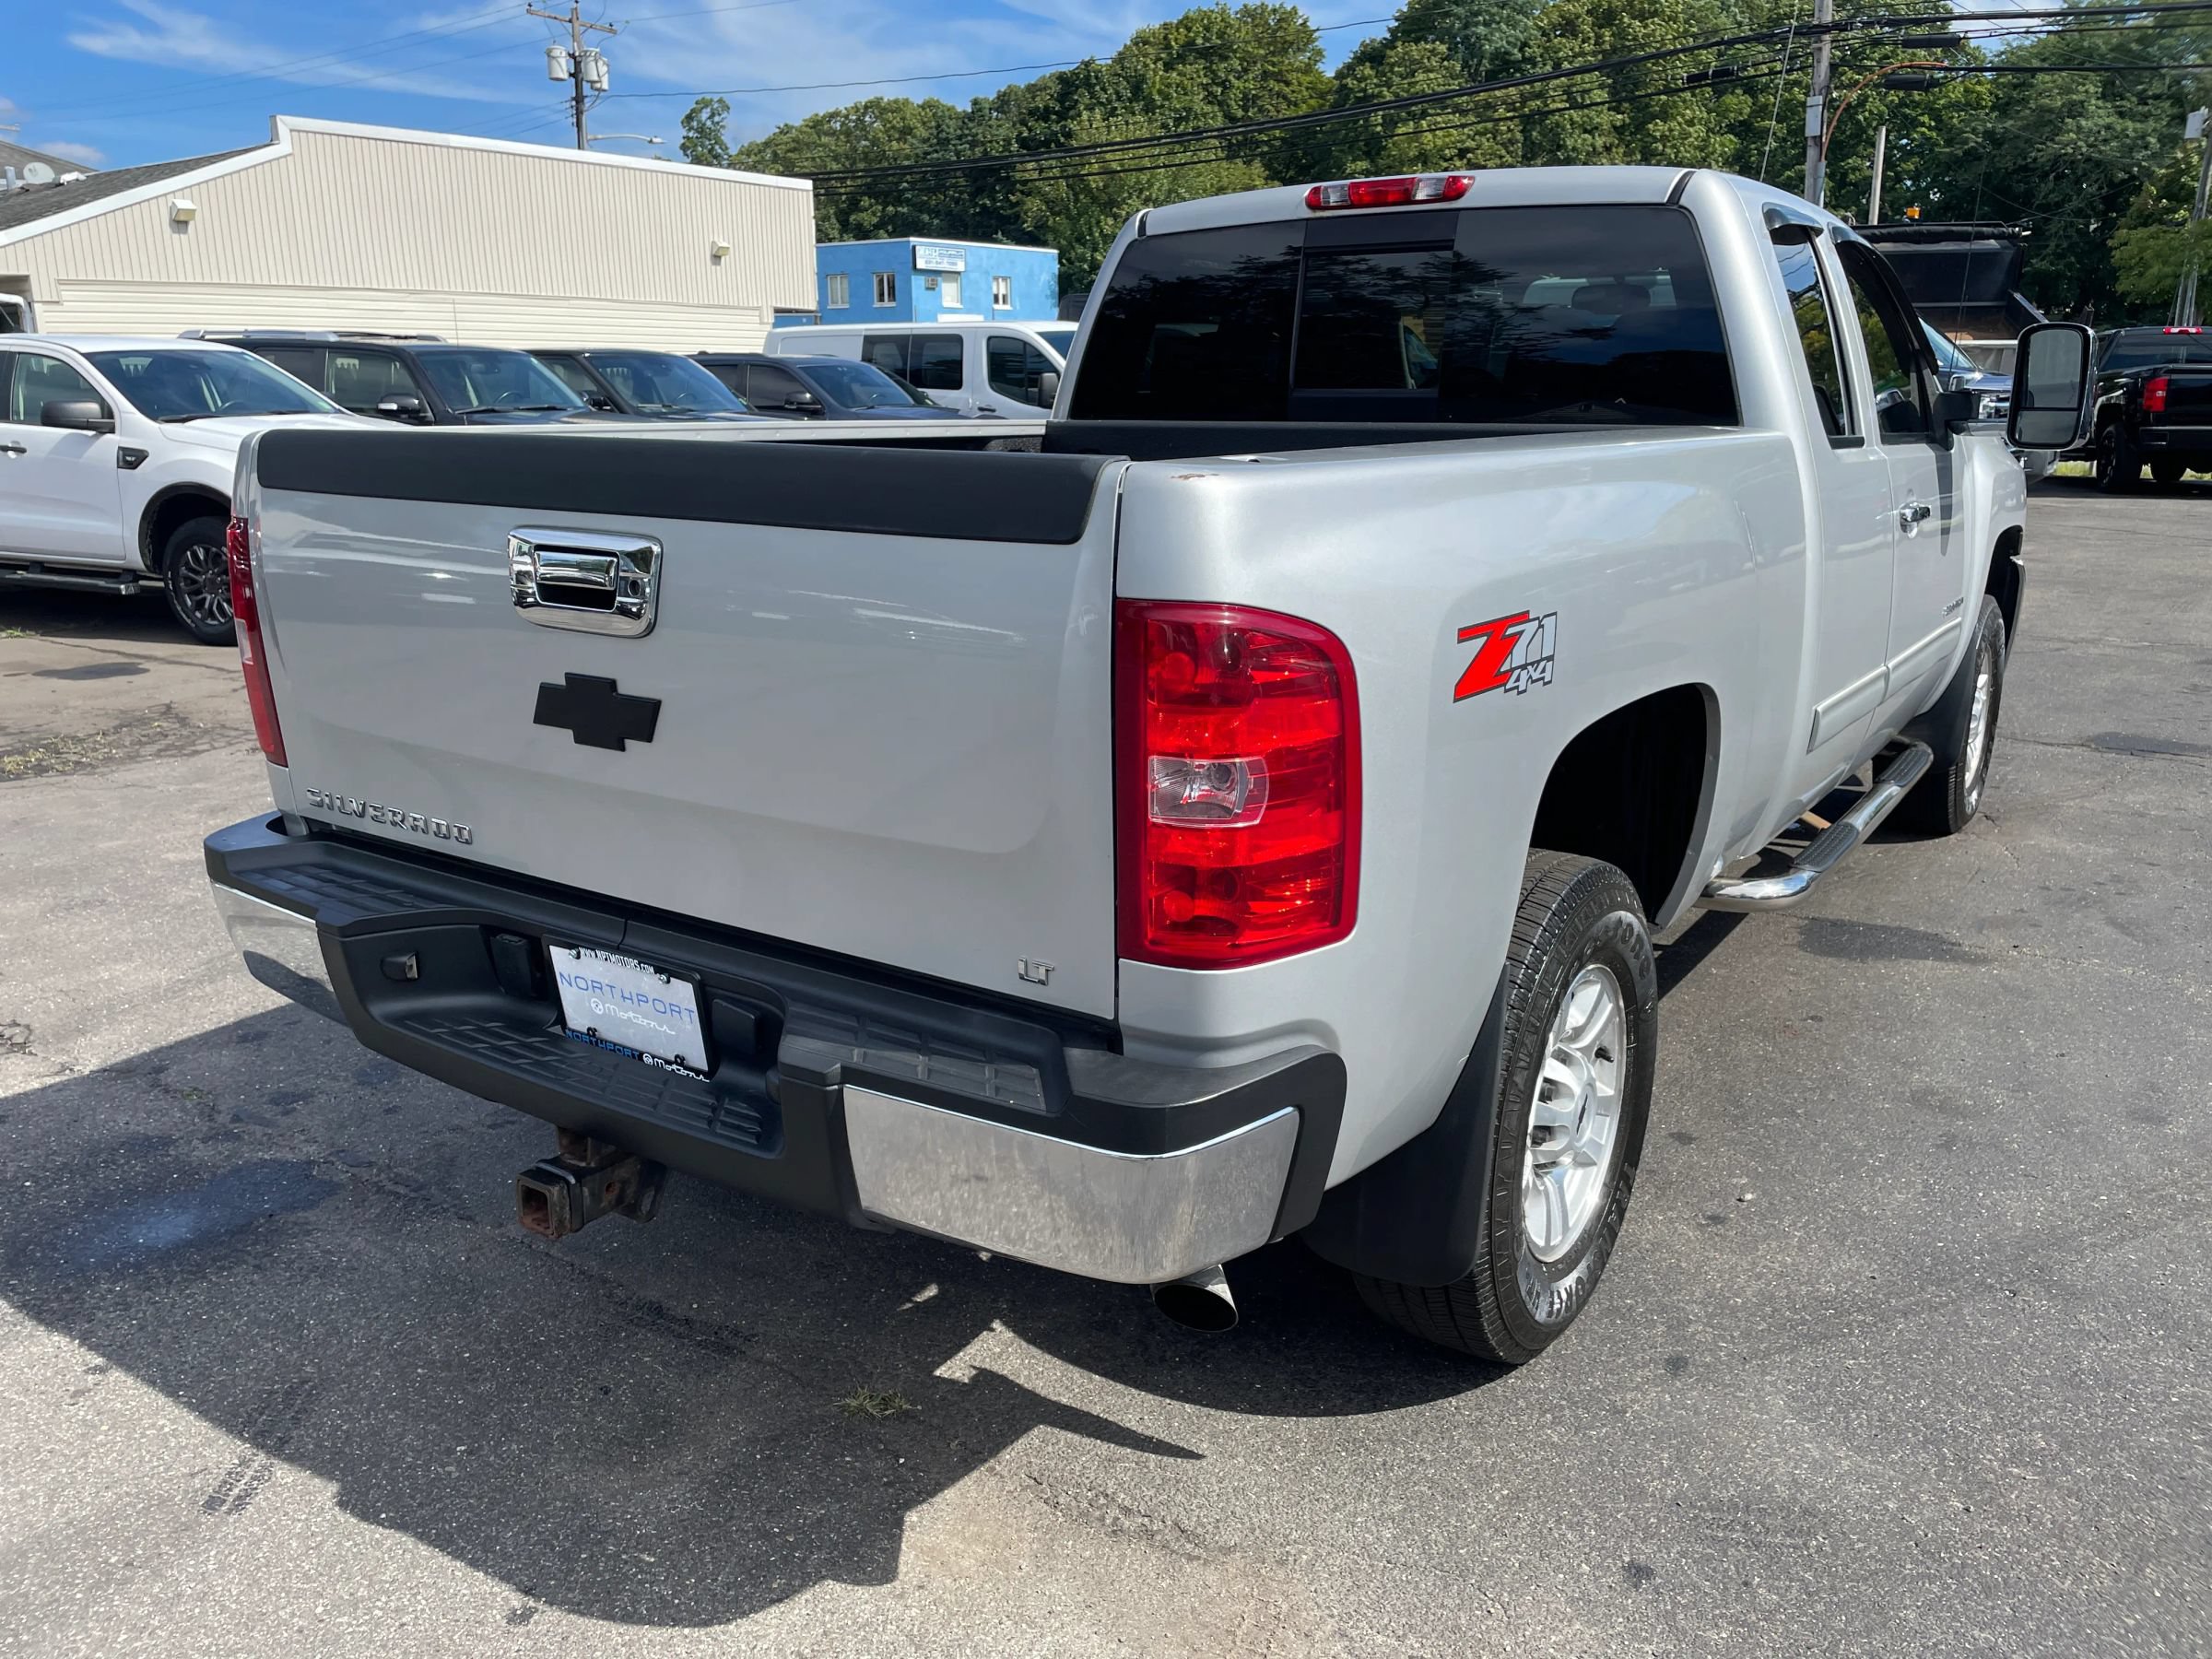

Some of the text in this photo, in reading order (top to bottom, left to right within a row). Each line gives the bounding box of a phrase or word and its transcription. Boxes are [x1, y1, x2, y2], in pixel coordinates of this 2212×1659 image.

[1452, 609, 1558, 703] Z71
[306, 787, 473, 845] SILVERADO
[559, 971, 695, 1024] NORTHPORT
[1018, 958, 1055, 987] LT
[564, 1029, 641, 1061] NORTHPORT
